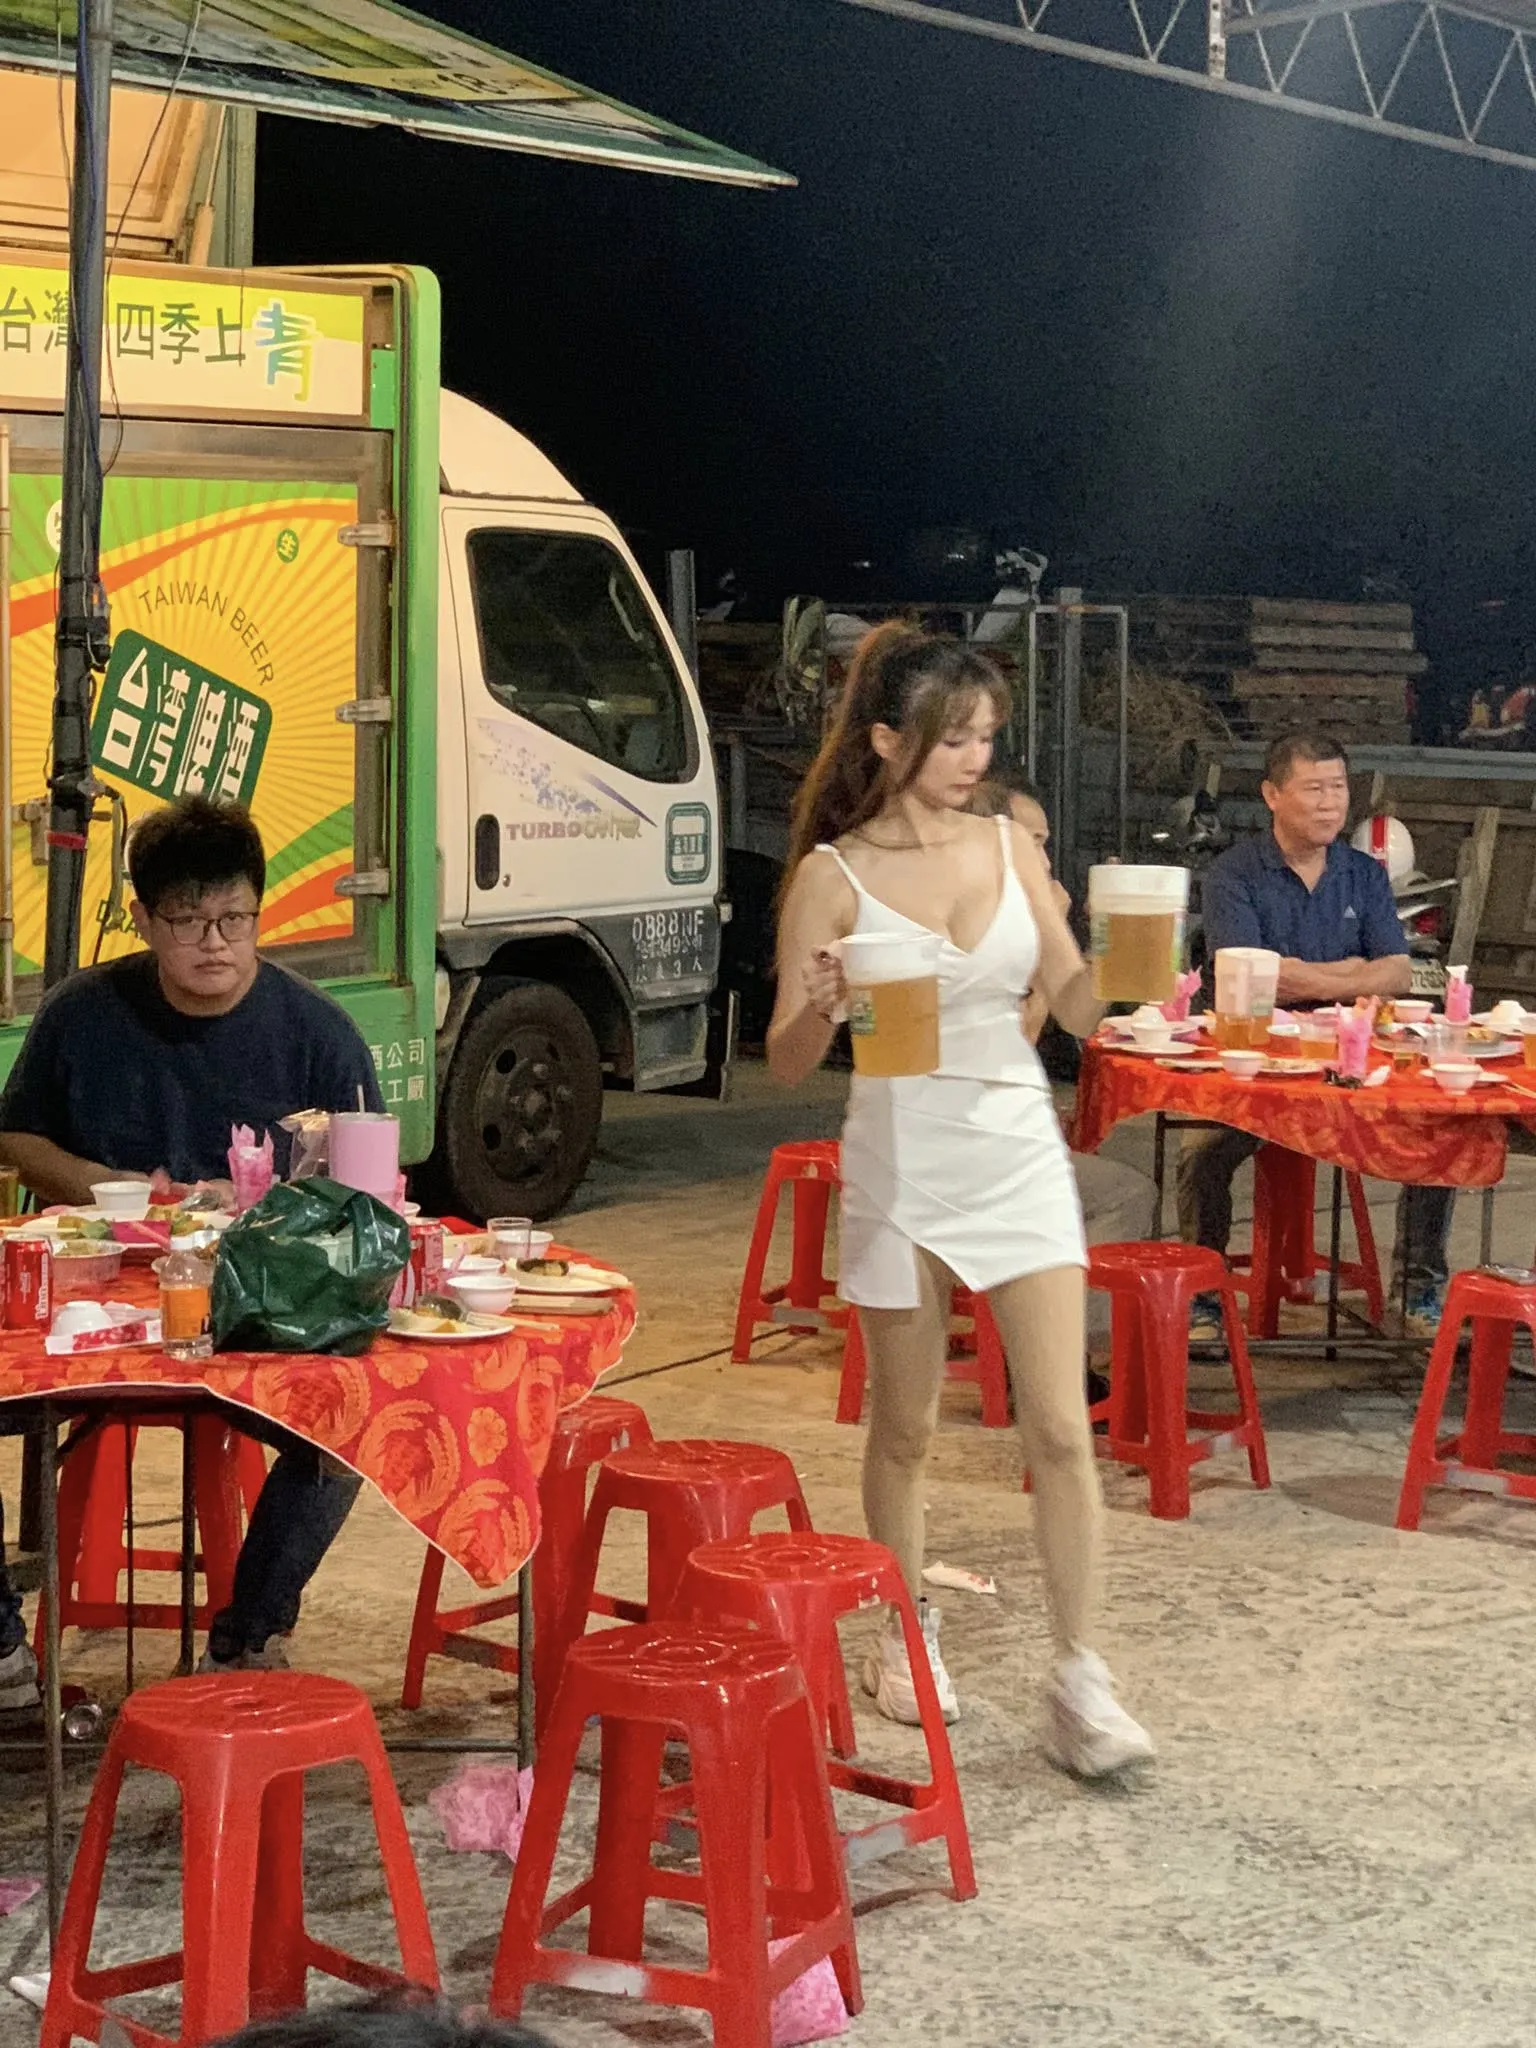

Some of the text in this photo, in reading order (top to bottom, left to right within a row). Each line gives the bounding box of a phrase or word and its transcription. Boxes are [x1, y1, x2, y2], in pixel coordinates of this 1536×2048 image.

[139, 581, 275, 687] TAIWAN BEER
[96, 900, 139, 939] DRA
